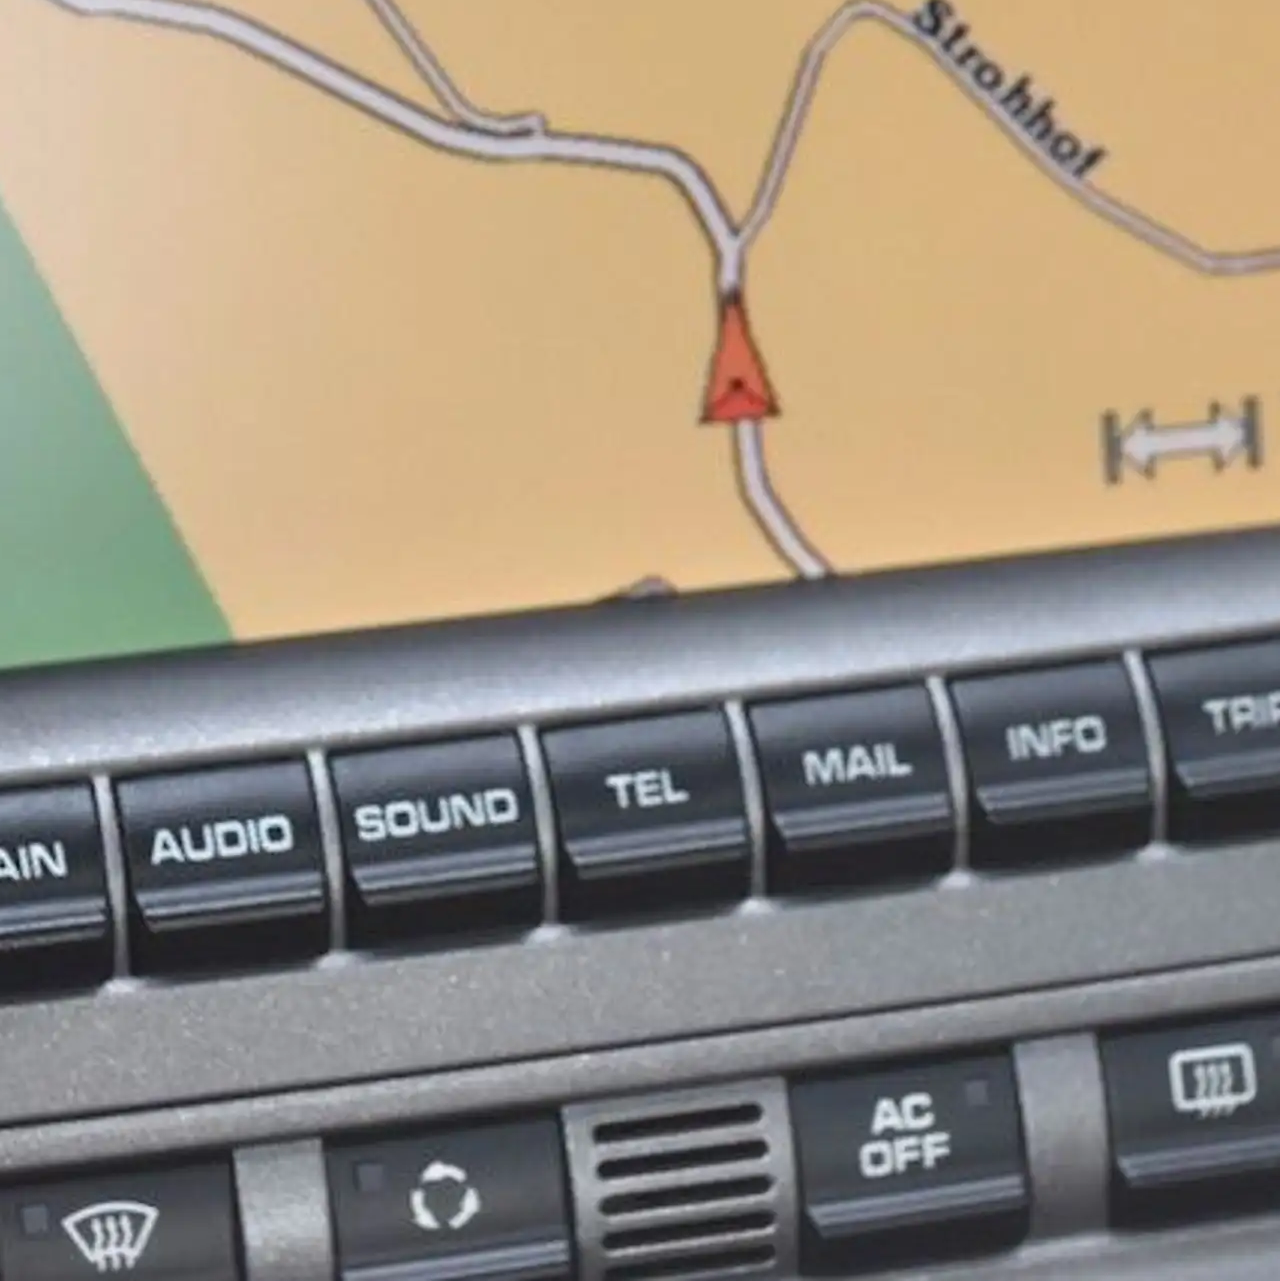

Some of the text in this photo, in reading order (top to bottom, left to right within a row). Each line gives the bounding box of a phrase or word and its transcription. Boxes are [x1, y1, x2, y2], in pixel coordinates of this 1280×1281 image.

[1006, 715, 1107, 760] INFO
[802, 743, 913, 785] MAIL
[605, 769, 690, 809] TEL
[353, 786, 519, 842] SOUND
[148, 812, 295, 866] AUDIO
[871, 1092, 936, 1135] AC
[859, 1132, 951, 1178] OFF
